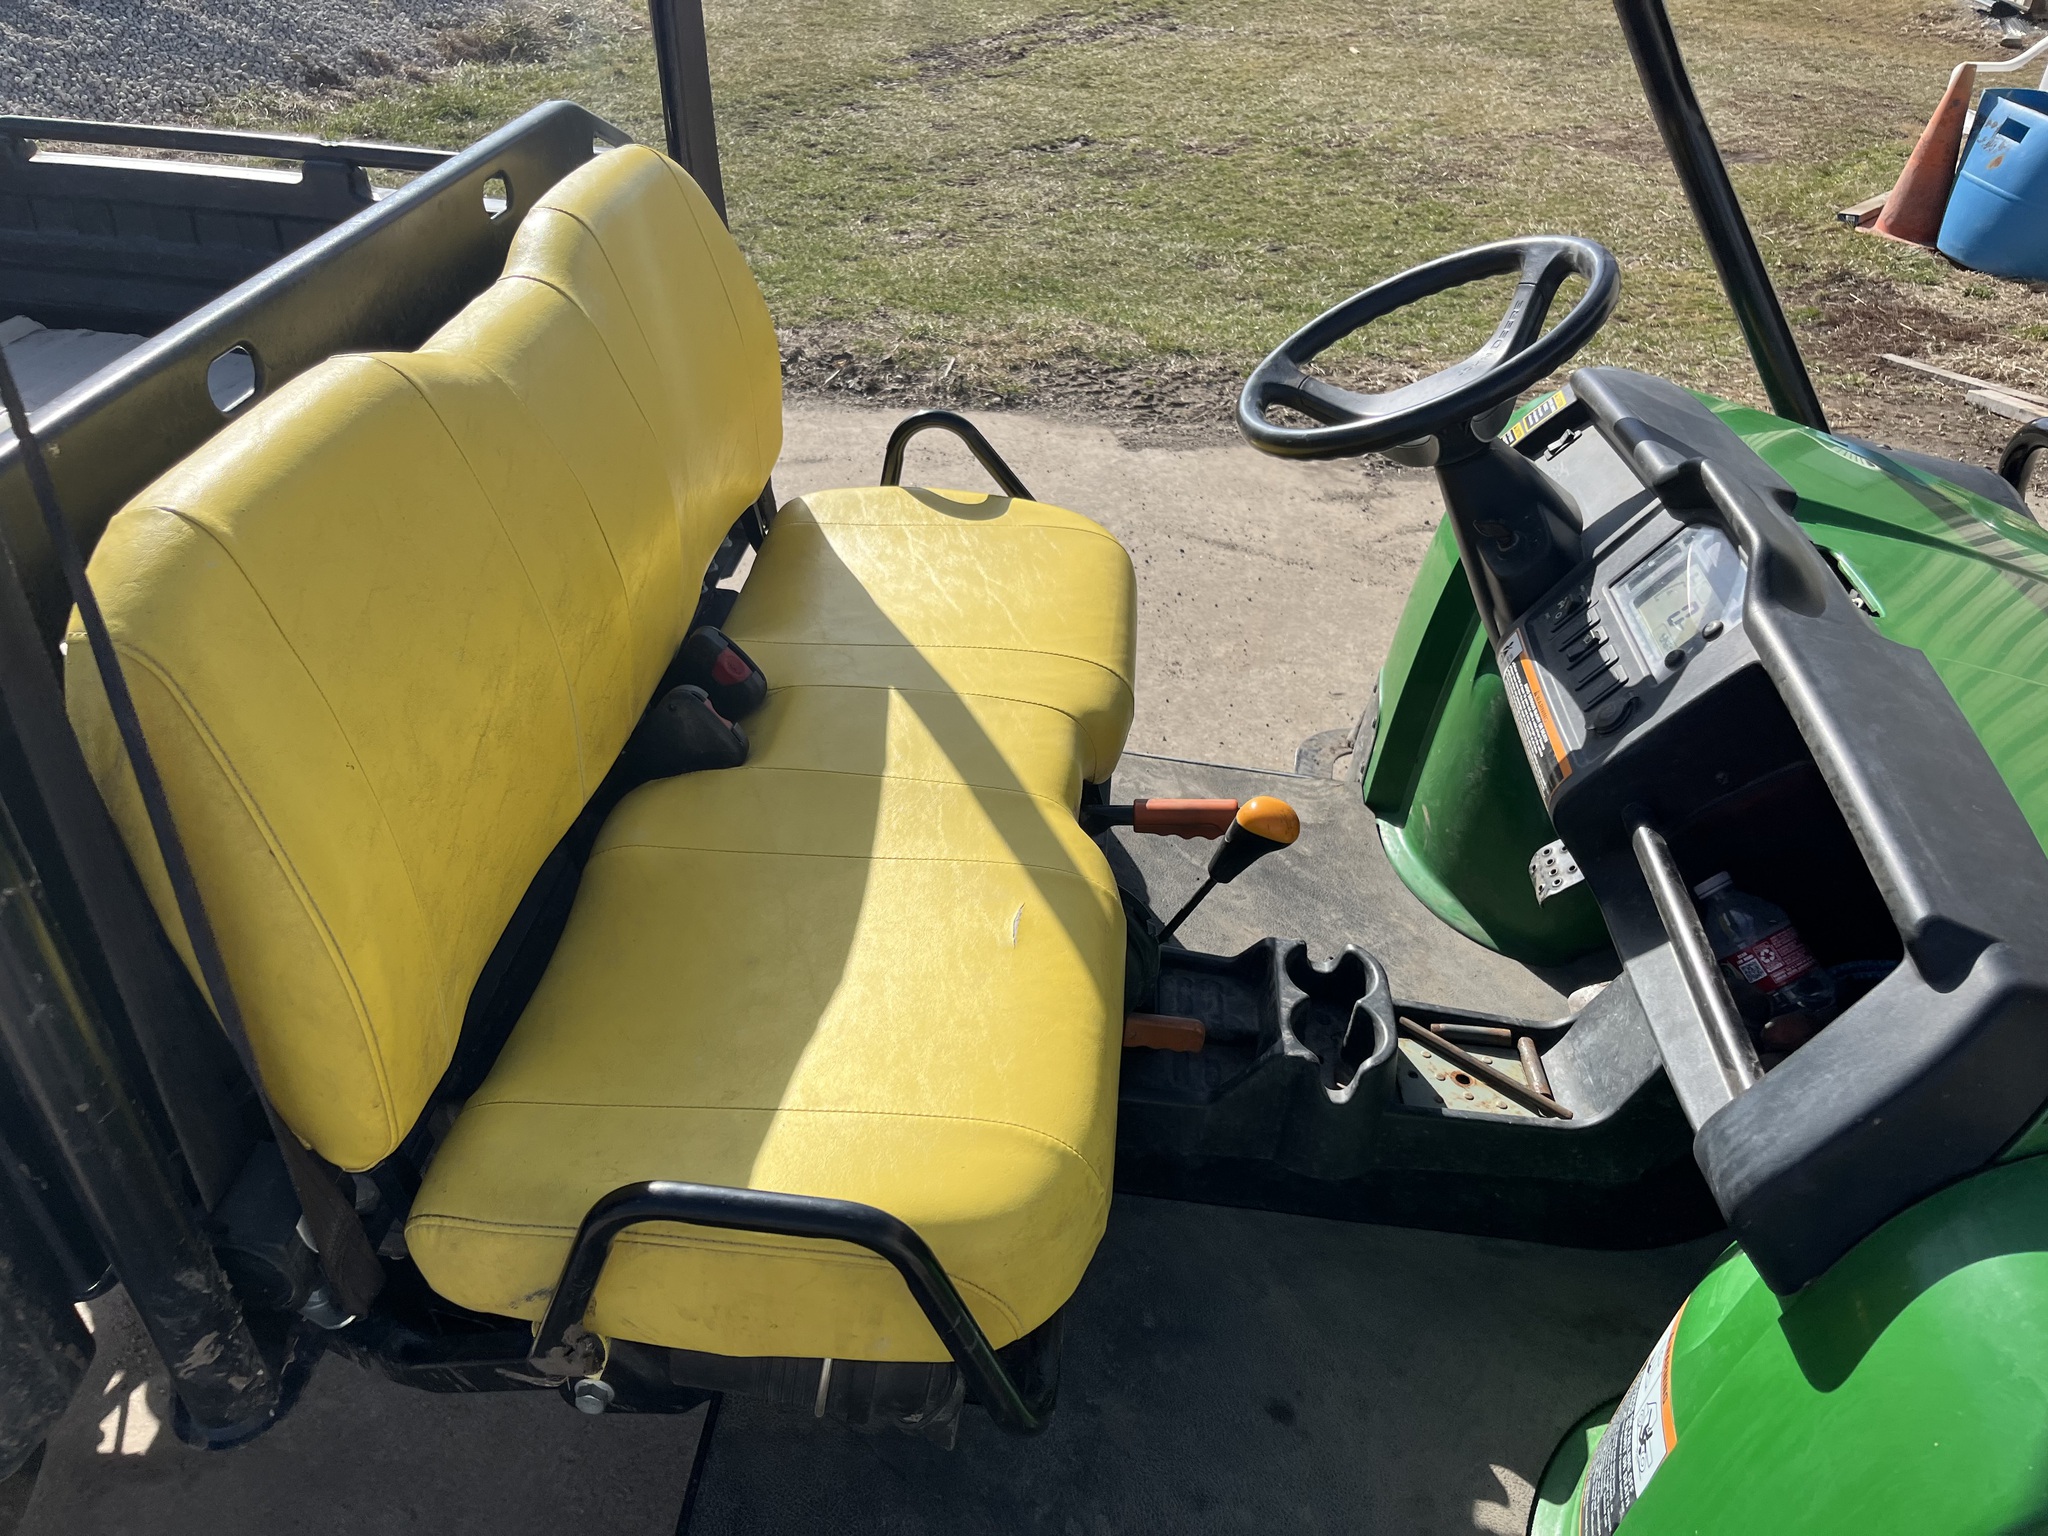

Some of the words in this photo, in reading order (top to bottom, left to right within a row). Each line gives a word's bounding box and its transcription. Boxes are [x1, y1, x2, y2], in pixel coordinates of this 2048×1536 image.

[1490, 300, 1523, 348] DEERE
[1535, 695, 1548, 721] WARNING
[1622, 1471, 1630, 1507] DEATH
